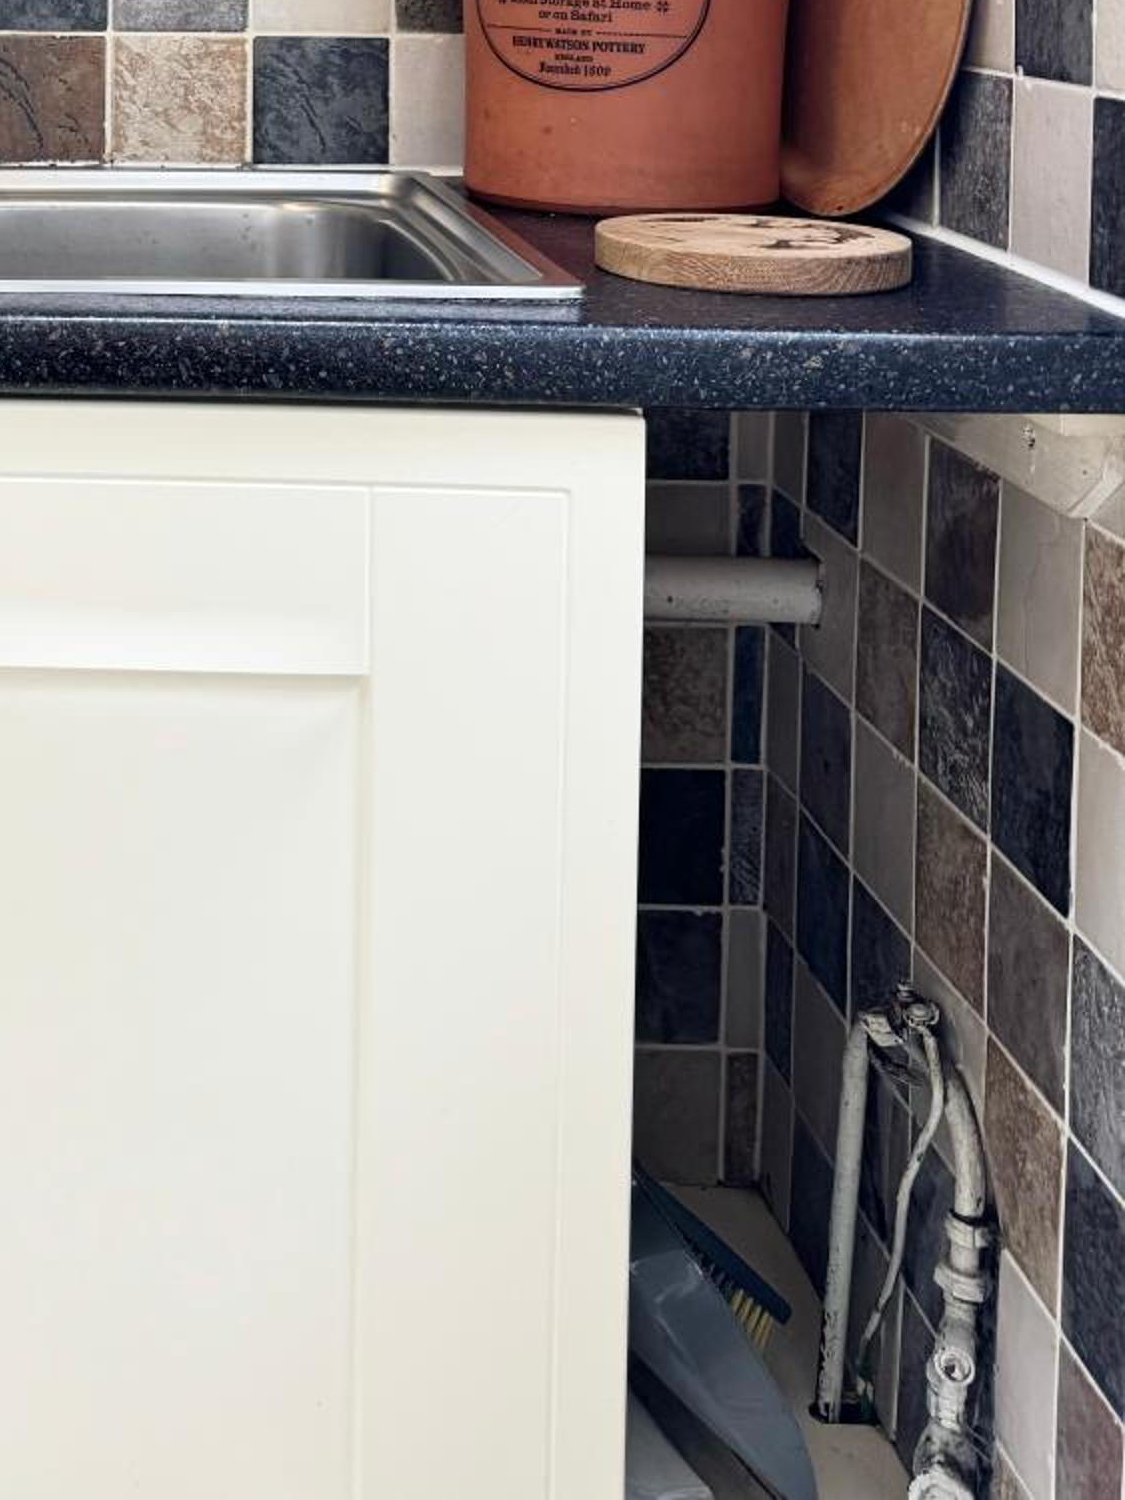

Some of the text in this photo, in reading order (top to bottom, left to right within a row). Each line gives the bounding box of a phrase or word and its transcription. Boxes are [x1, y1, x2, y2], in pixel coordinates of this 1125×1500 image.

[538, 10, 613, 23] or on Safari
[592, 38, 646, 55] POTTERY
